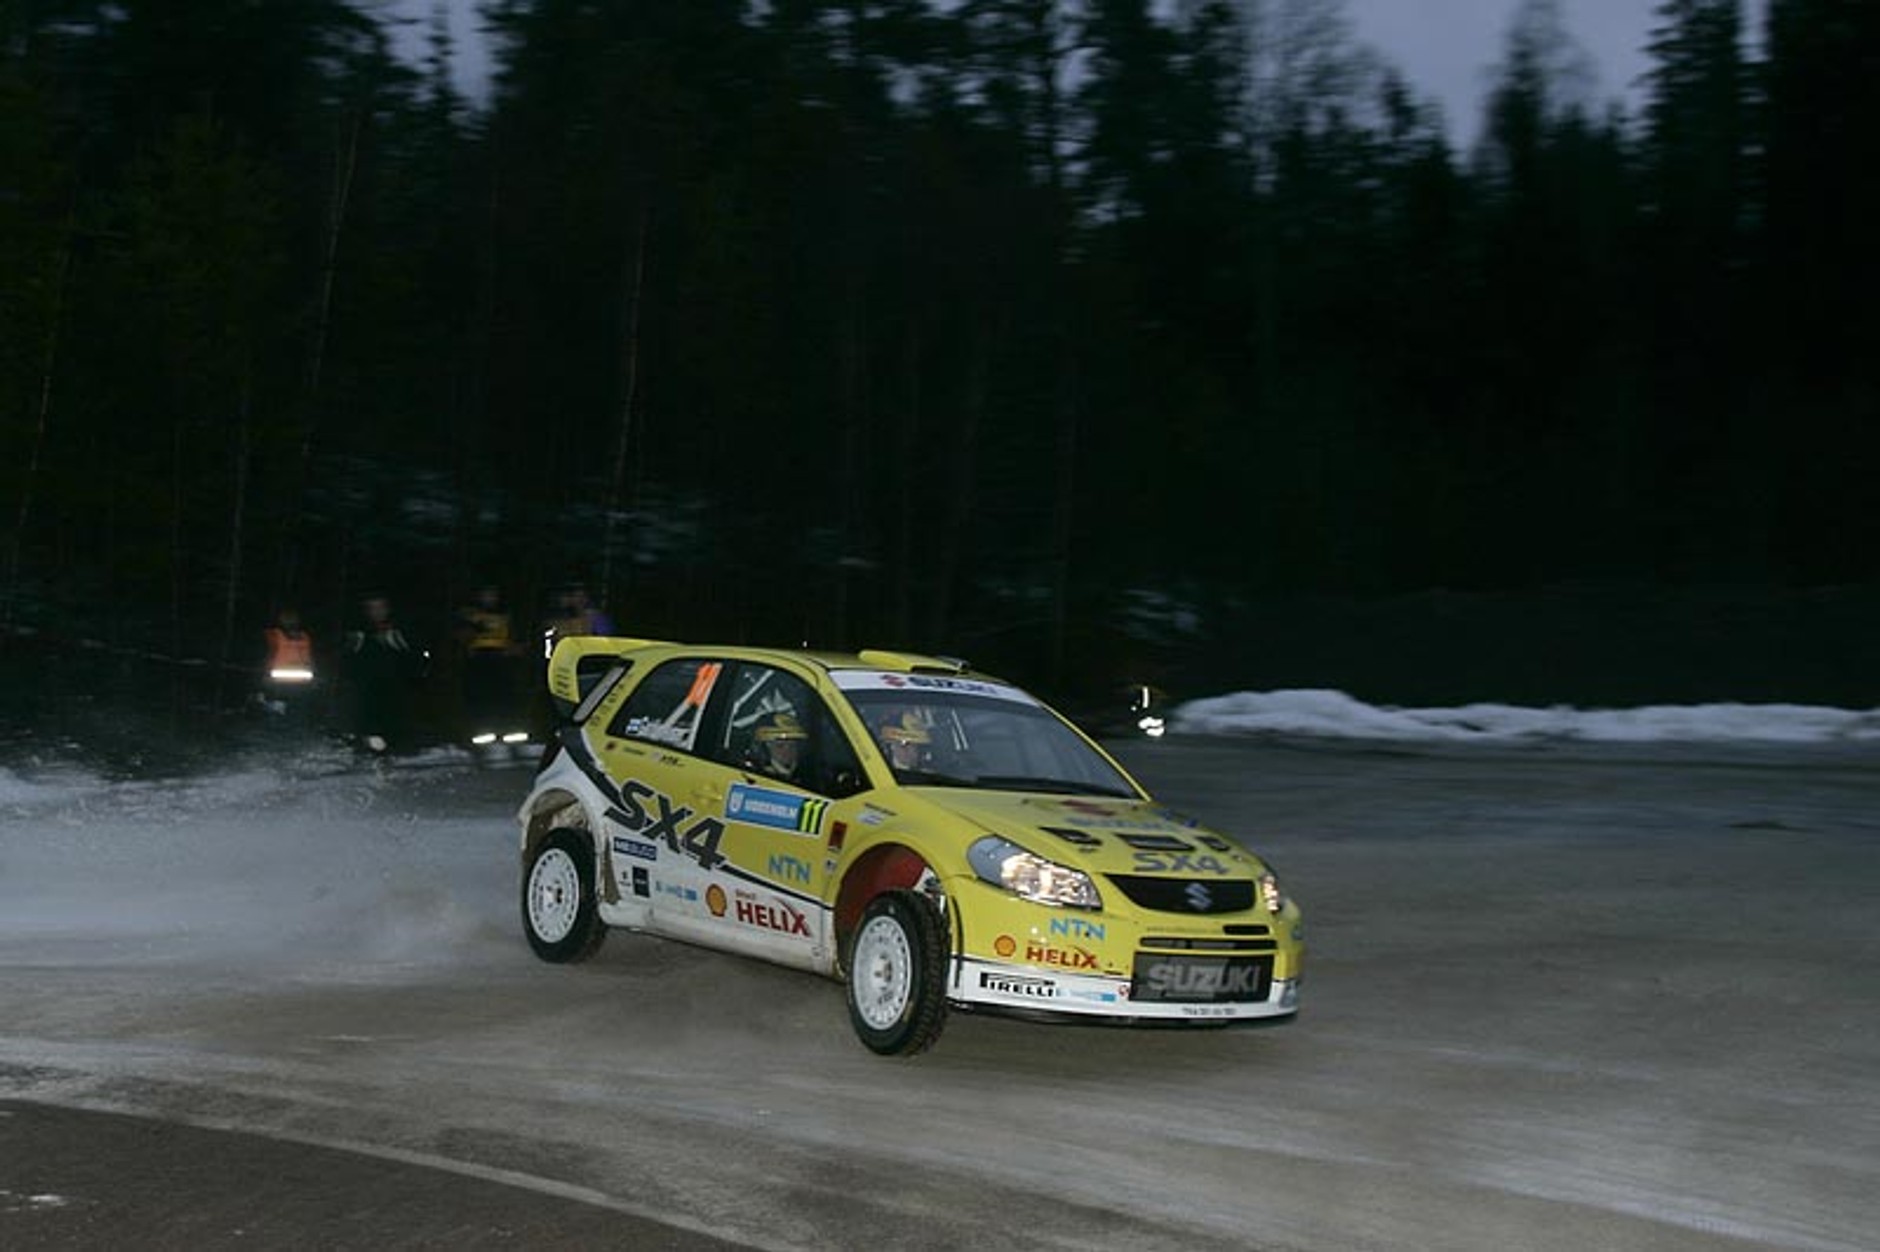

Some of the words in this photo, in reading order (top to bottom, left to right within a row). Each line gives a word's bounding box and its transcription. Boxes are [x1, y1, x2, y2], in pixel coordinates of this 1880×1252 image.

[605, 781, 726, 870] SX4
[799, 800, 822, 832] 11
[768, 853, 811, 884] NTN
[1133, 852, 1228, 875] SX4
[736, 897, 813, 937] HELIX
[1049, 917, 1106, 940] NTN
[1025, 944, 1099, 969] HELIX
[980, 971, 1055, 997] PIRELLI
[1147, 961, 1262, 993] SUZUKI
